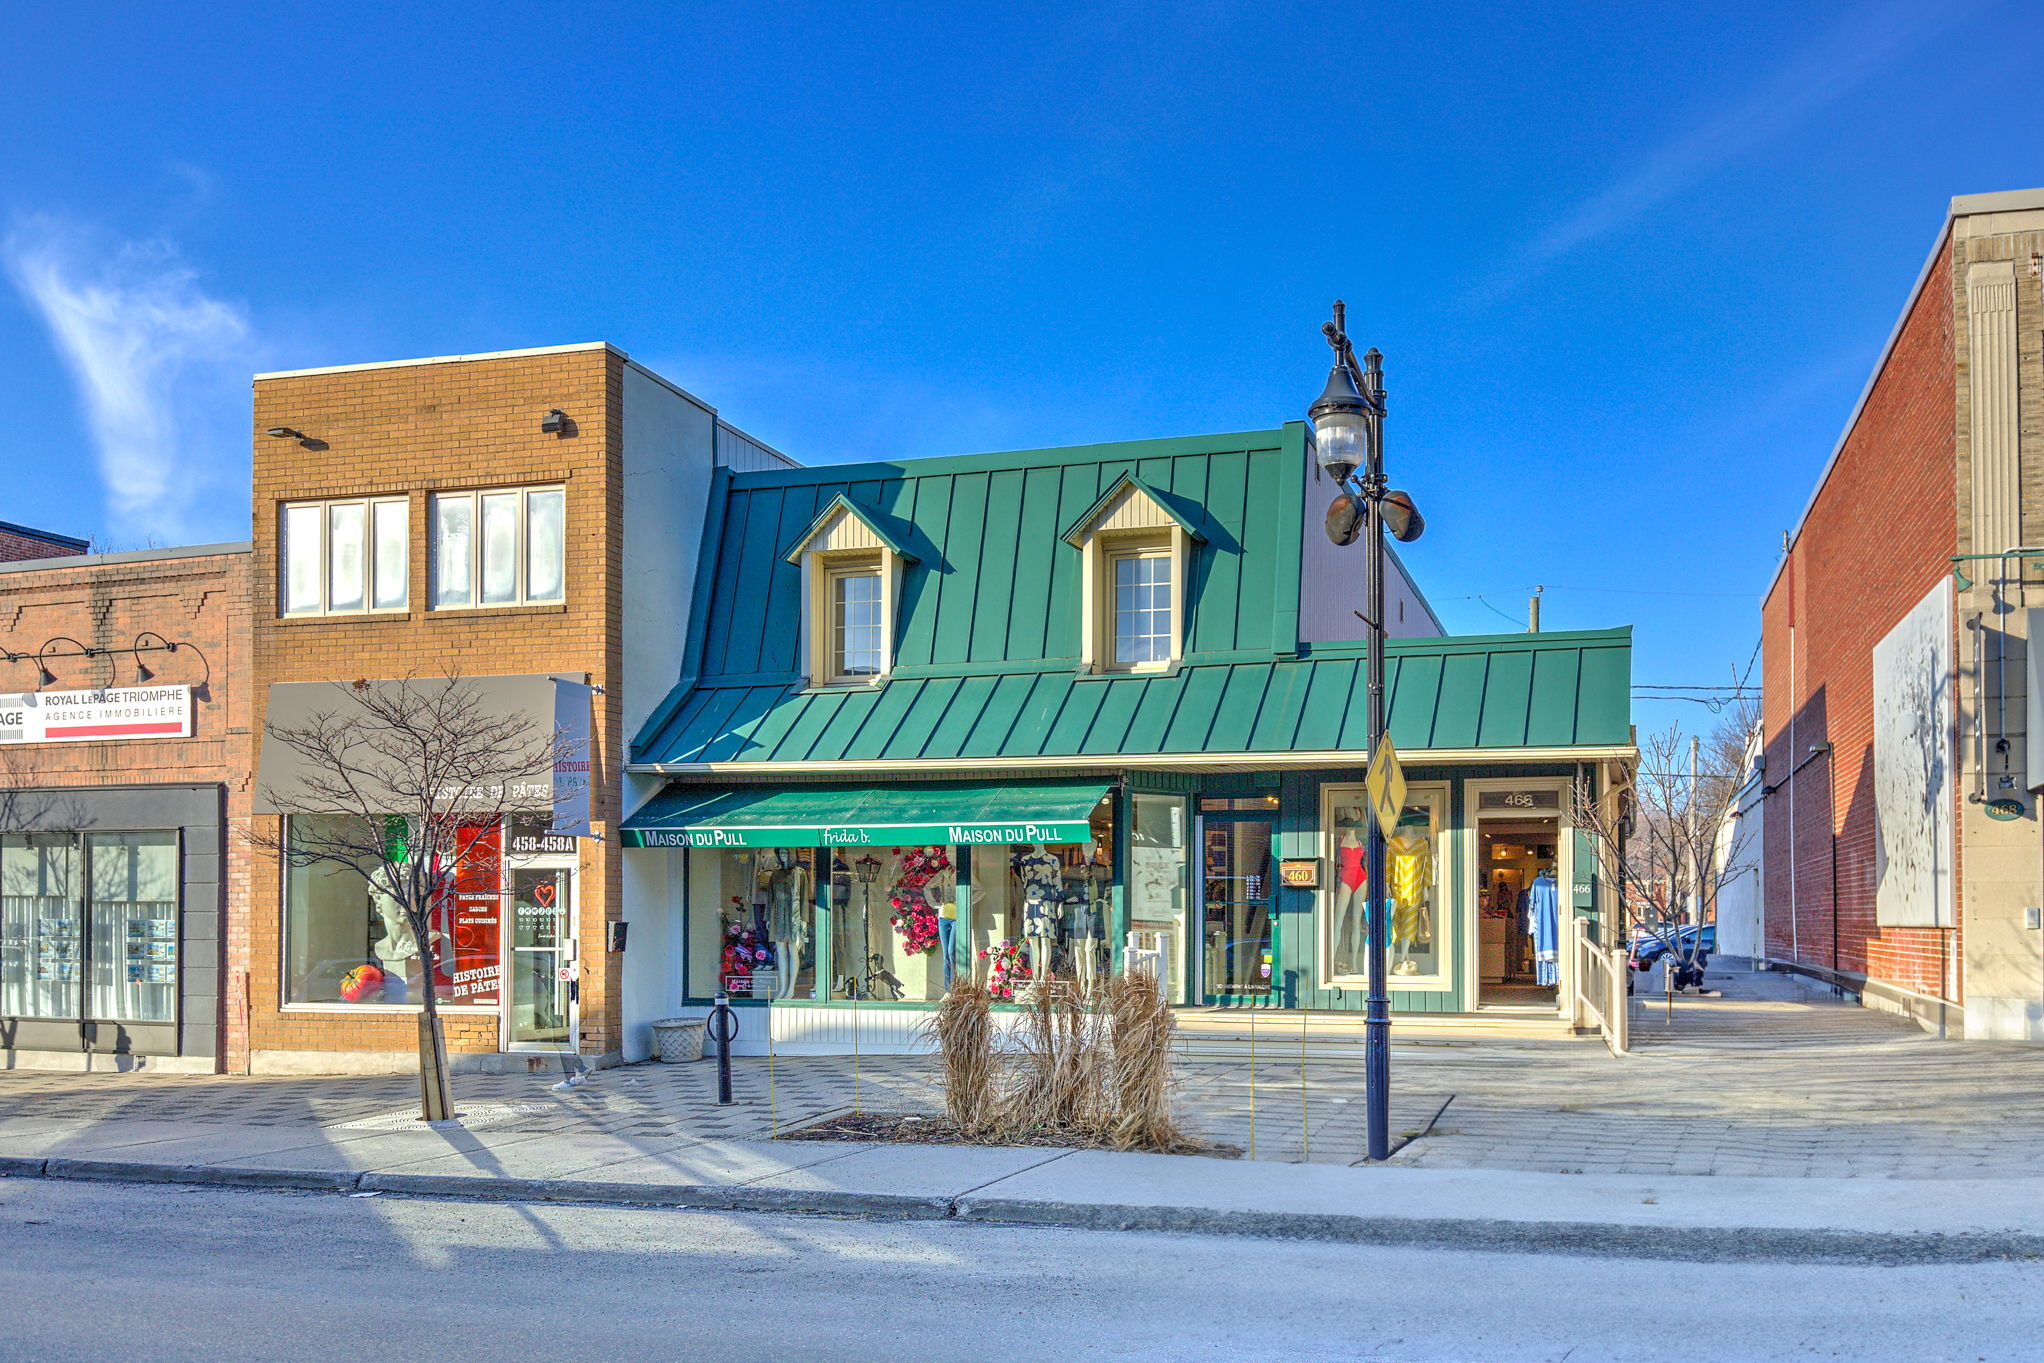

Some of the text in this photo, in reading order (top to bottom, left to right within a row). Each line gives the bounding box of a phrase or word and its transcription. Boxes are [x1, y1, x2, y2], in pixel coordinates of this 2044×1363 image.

[45, 695, 79, 706] ROYAL
[122, 689, 183, 702] TRIOMPHE
[45, 710, 92, 720] AGENCE
[512, 781, 549, 798] PÂTES
[1504, 794, 1533, 806] 466
[1991, 804, 2017, 815] 468
[645, 829, 748, 846] MAISON DU PULL
[823, 827, 859, 846] frida
[948, 824, 1062, 843] MAISON DU PULL
[512, 836, 574, 851] 458-458A
[1288, 870, 1308, 881] 460
[1573, 884, 1591, 894] 466
[453, 965, 500, 984] HISTOIRE
[454, 984, 469, 997] DE
